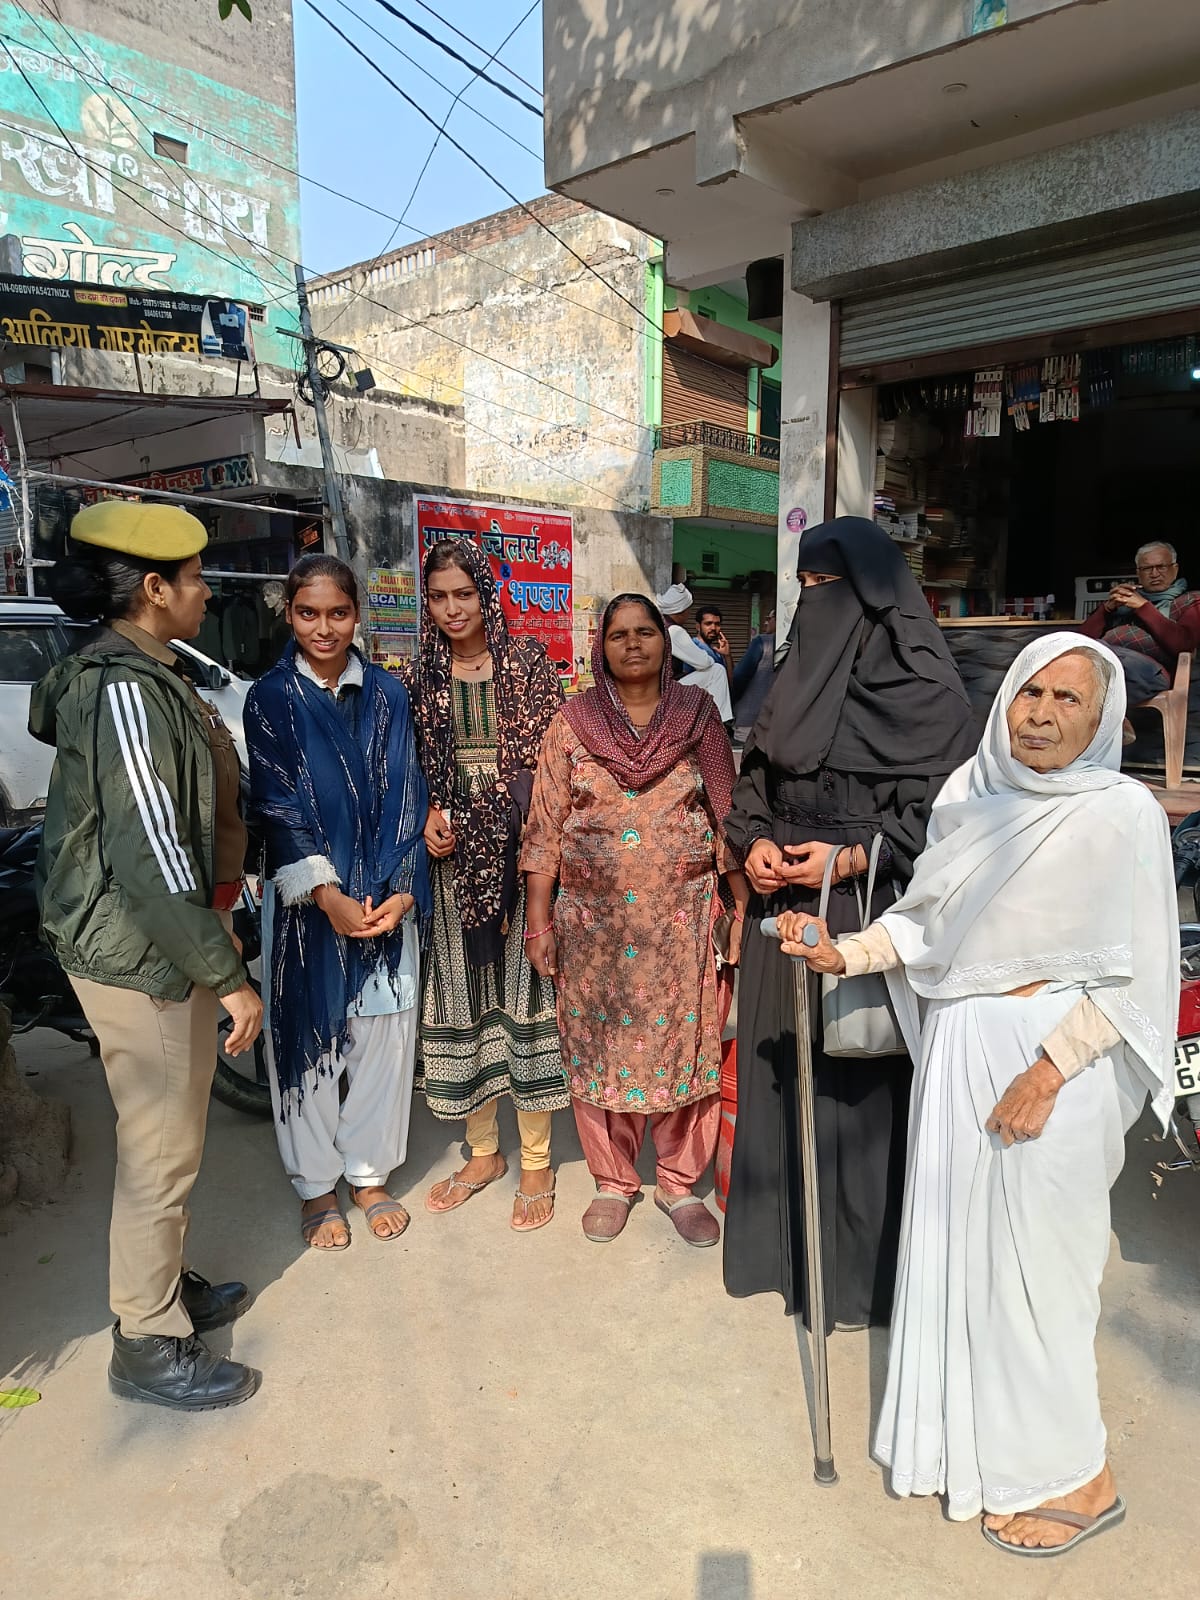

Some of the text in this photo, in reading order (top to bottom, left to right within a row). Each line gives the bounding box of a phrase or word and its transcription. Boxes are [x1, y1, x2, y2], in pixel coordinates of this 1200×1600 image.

[1, 308, 90, 349] आलिया
[480, 518, 541, 564] ज्वैलर्स
[370, 594, 396, 605] BCA
[508, 580, 571, 613] भण्डार
